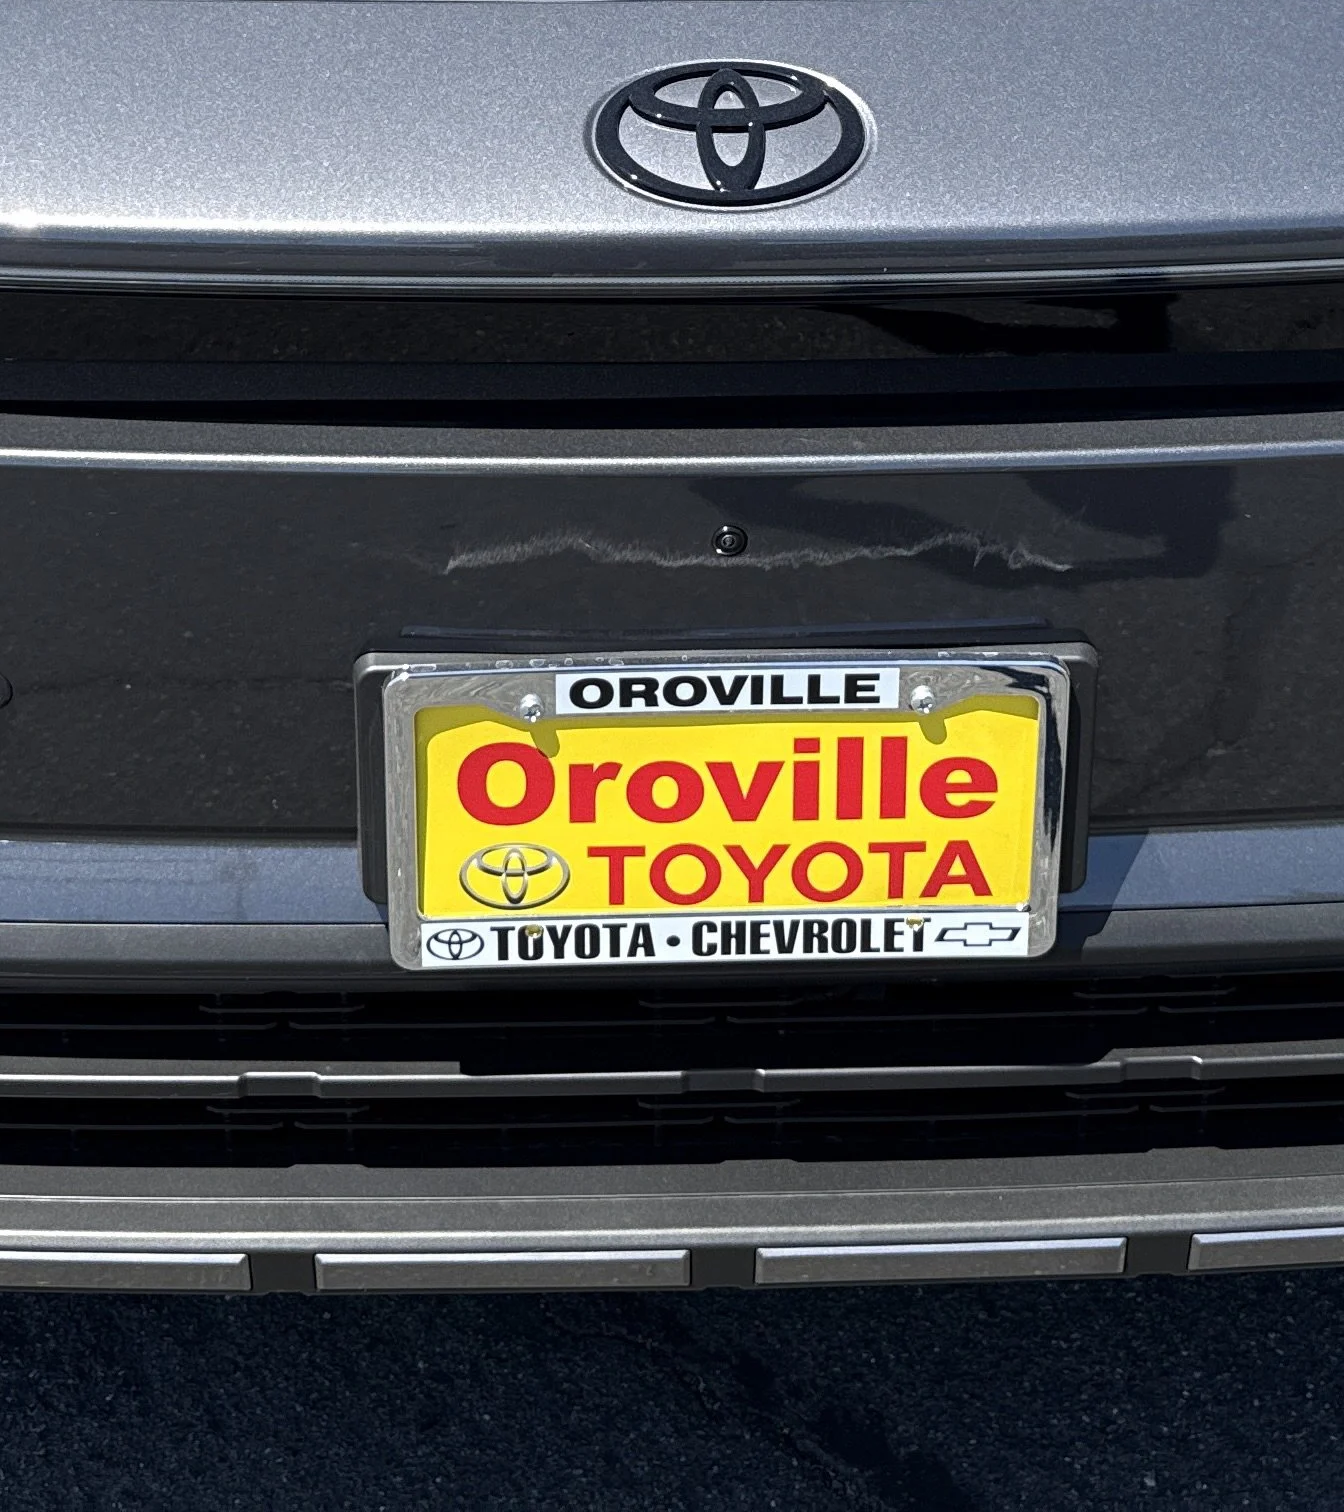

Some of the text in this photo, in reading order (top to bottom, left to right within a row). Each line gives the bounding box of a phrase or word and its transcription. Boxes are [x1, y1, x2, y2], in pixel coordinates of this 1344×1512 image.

[567, 672, 881, 710] OROVILLE
[456, 735, 1000, 826] Oroville
[587, 839, 993, 906] TOYOTA
[490, 917, 932, 961] TOYOTA CHEVROLET
